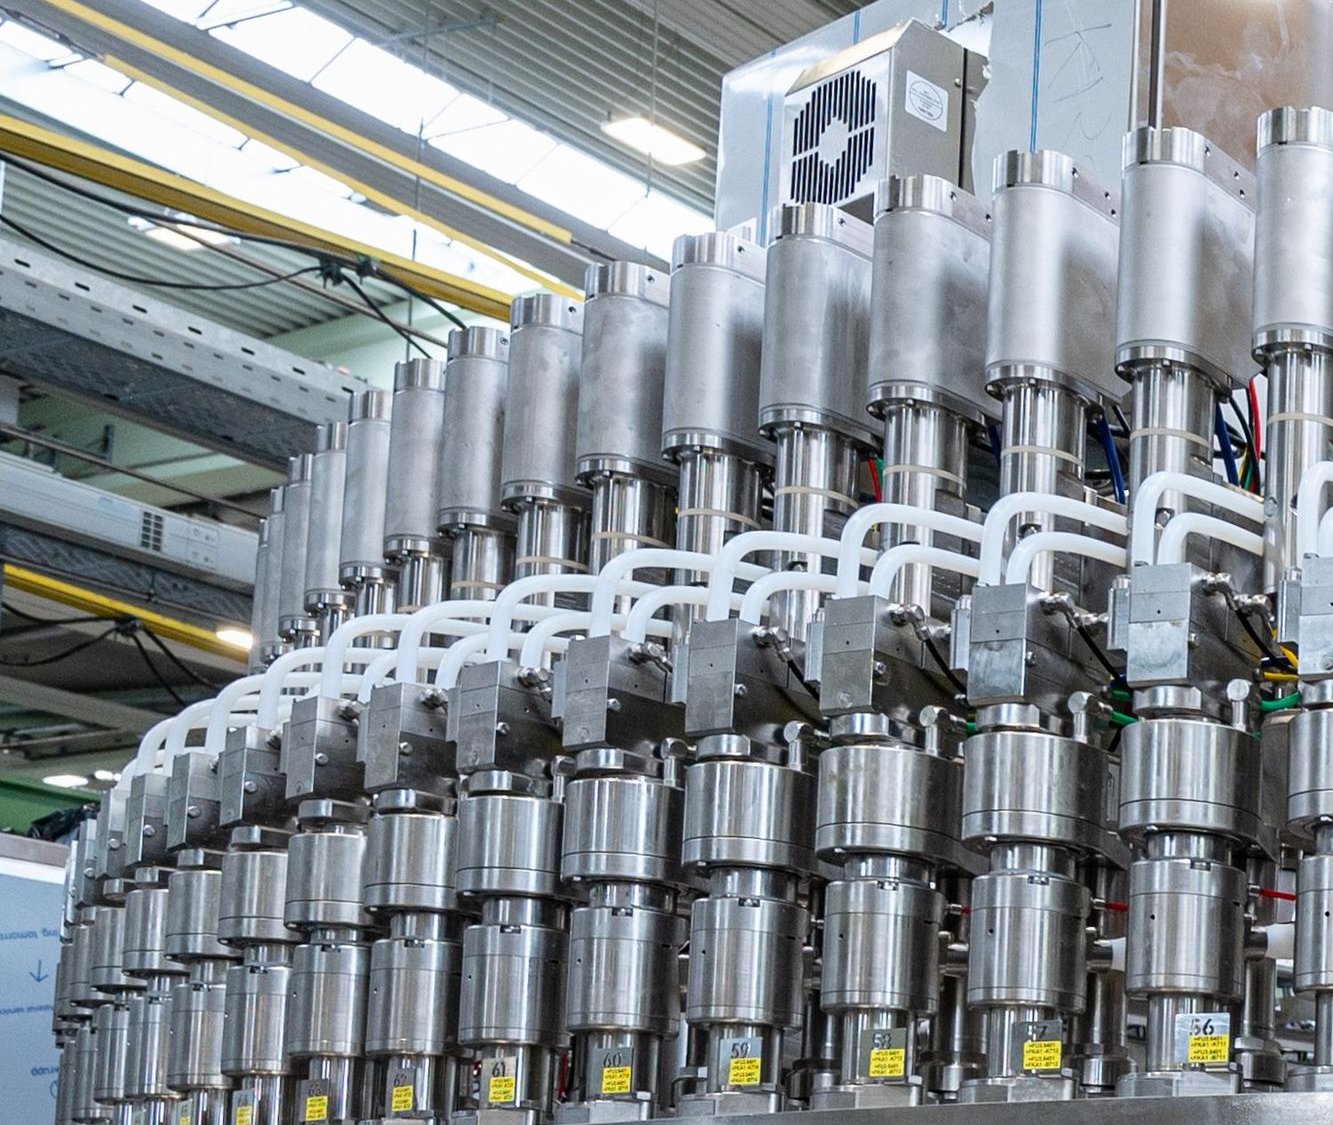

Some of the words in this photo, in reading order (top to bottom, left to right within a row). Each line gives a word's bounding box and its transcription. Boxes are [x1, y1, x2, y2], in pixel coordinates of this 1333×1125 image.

[1190, 1018, 1214, 1035] 56
[731, 1042, 750, 1059] 59
[603, 1052, 622, 1068] 60
[492, 1061, 505, 1077] 61
